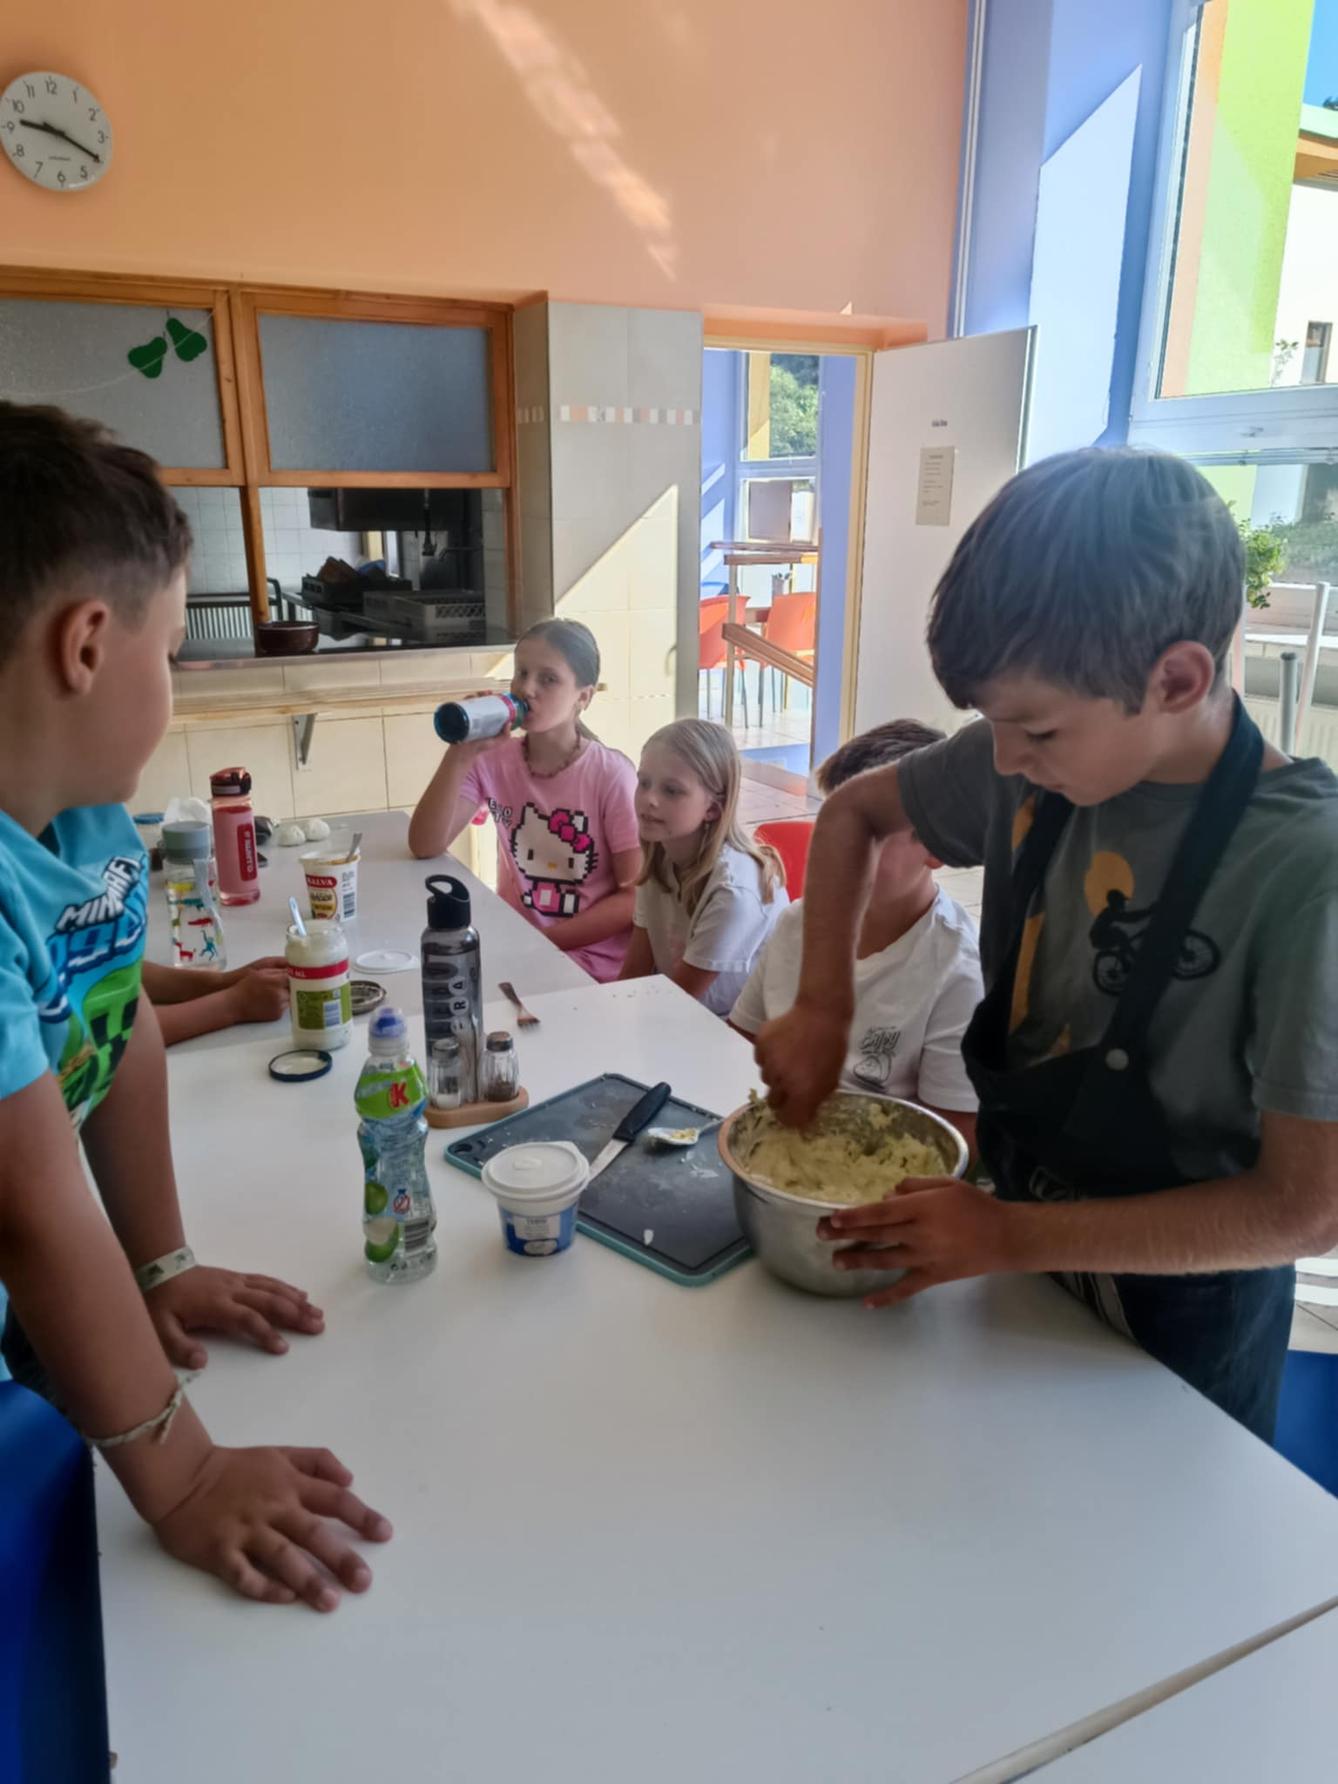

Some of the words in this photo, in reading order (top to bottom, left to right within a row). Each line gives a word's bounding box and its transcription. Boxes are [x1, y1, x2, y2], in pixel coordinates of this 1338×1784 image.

[26, 83, 36, 99] 11
[45, 78, 58, 96] 12
[72, 90, 78, 104] 1
[12, 99, 25, 114] 10
[88, 107, 97, 121] 2
[6, 121, 15, 133] 9
[97, 130, 105, 144] 3
[16, 143, 25, 158] 8
[35, 161, 43, 179] 7
[57, 170, 67, 185] 6
[80, 165, 89, 181] 5
